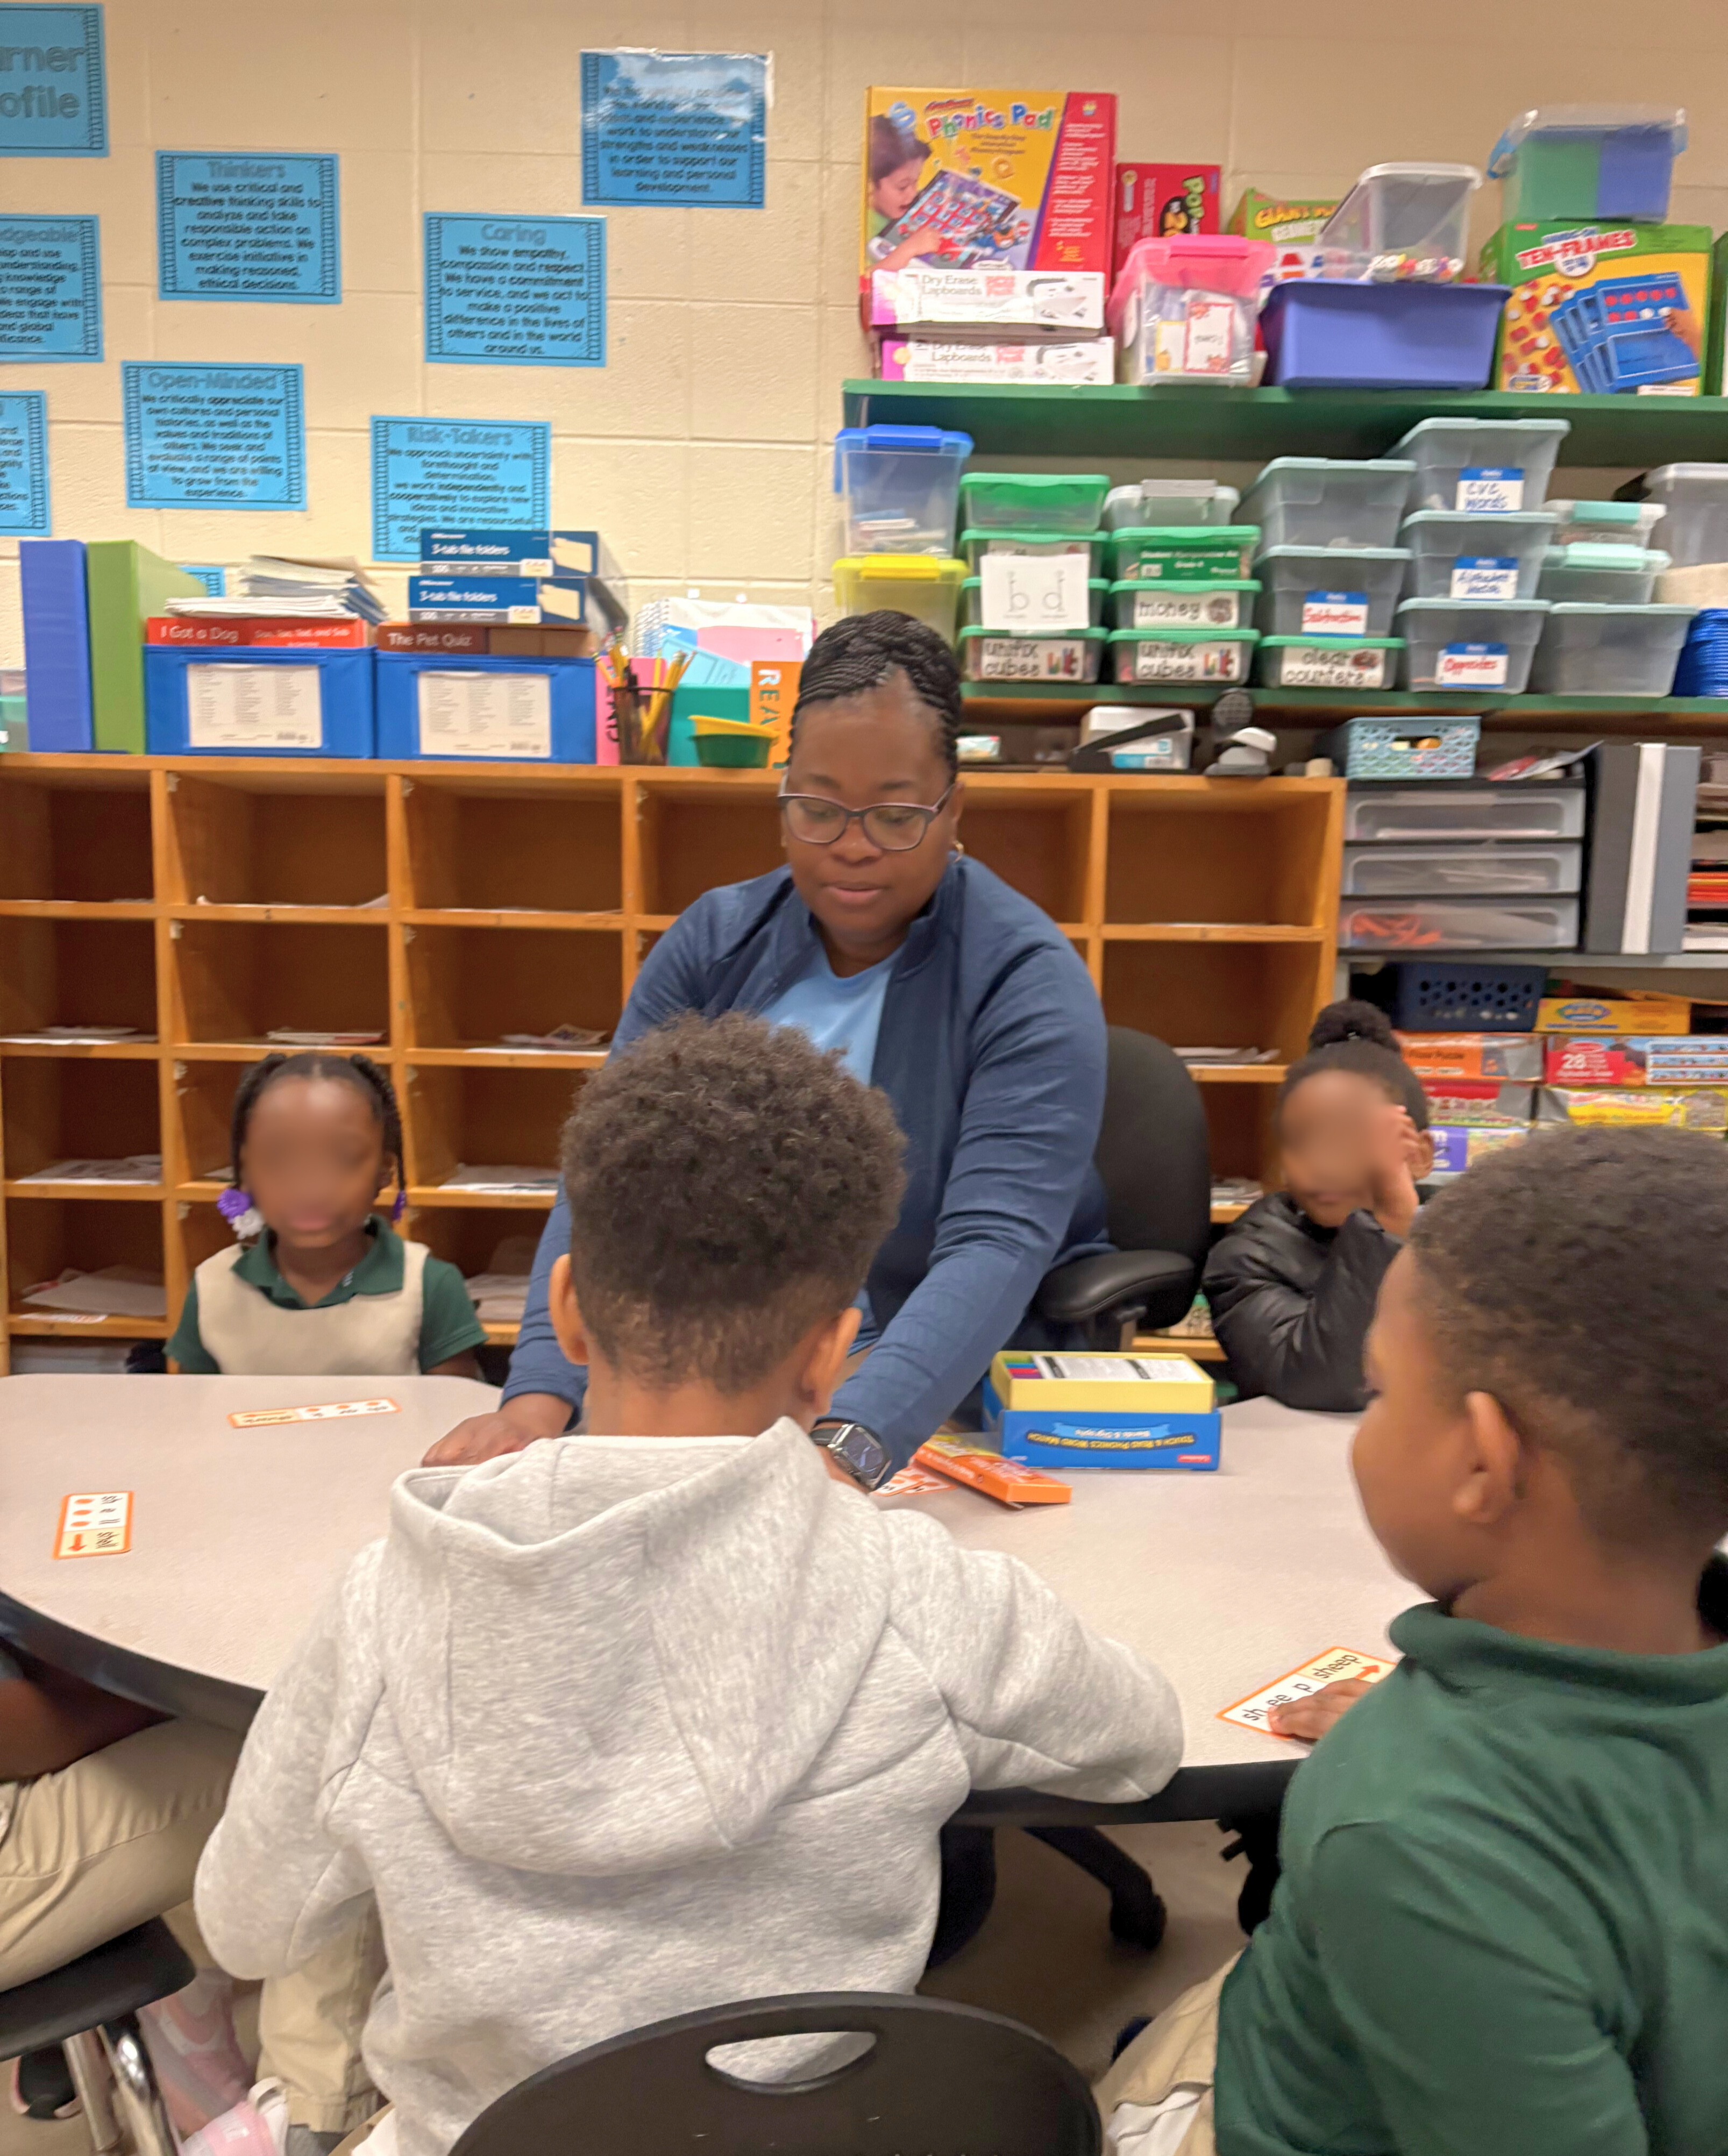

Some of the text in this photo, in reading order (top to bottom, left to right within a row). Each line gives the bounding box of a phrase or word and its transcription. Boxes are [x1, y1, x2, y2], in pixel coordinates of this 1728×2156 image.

[926, 105, 1005, 139] Phonics
[1011, 102, 1056, 130] Pad
[207, 160, 285, 179] Thinkers
[191, 181, 209, 193] We
[211, 183, 231, 193] use
[280, 183, 304, 194] and
[228, 196, 275, 209] thinking
[246, 211, 269, 221] and
[181, 238, 231, 249] complex
[481, 223, 547, 246] Caring
[459, 245, 509, 256] We show
[514, 262, 536, 271] and
[445, 273, 461, 282] We
[465, 274, 495, 284] have
[497, 276, 507, 284] a
[922, 275, 979, 286] Dry Erase
[922, 284, 982, 296] Lapboards
[932, 351, 992, 362] Lapboards
[147, 372, 277, 392] Open-Minded
[406, 426, 513, 446] Risk-Takers
[1466, 482, 1500, 495] CVC
[1008, 579, 1065, 613] b d
[1139, 601, 1200, 620] money
[161, 625, 239, 643] I Got a Dog
[387, 632, 473, 648] The Pet Quiz
[1302, 647, 1350, 666] clear
[985, 658, 1040, 677] cubes
[1141, 660, 1196, 678] cubes
[1285, 667, 1364, 685] counters
[1089, 1440, 1129, 1449] PHONICS
[1312, 1654, 1362, 1679] sheep
[1242, 1682, 1316, 1721] sh ee p
